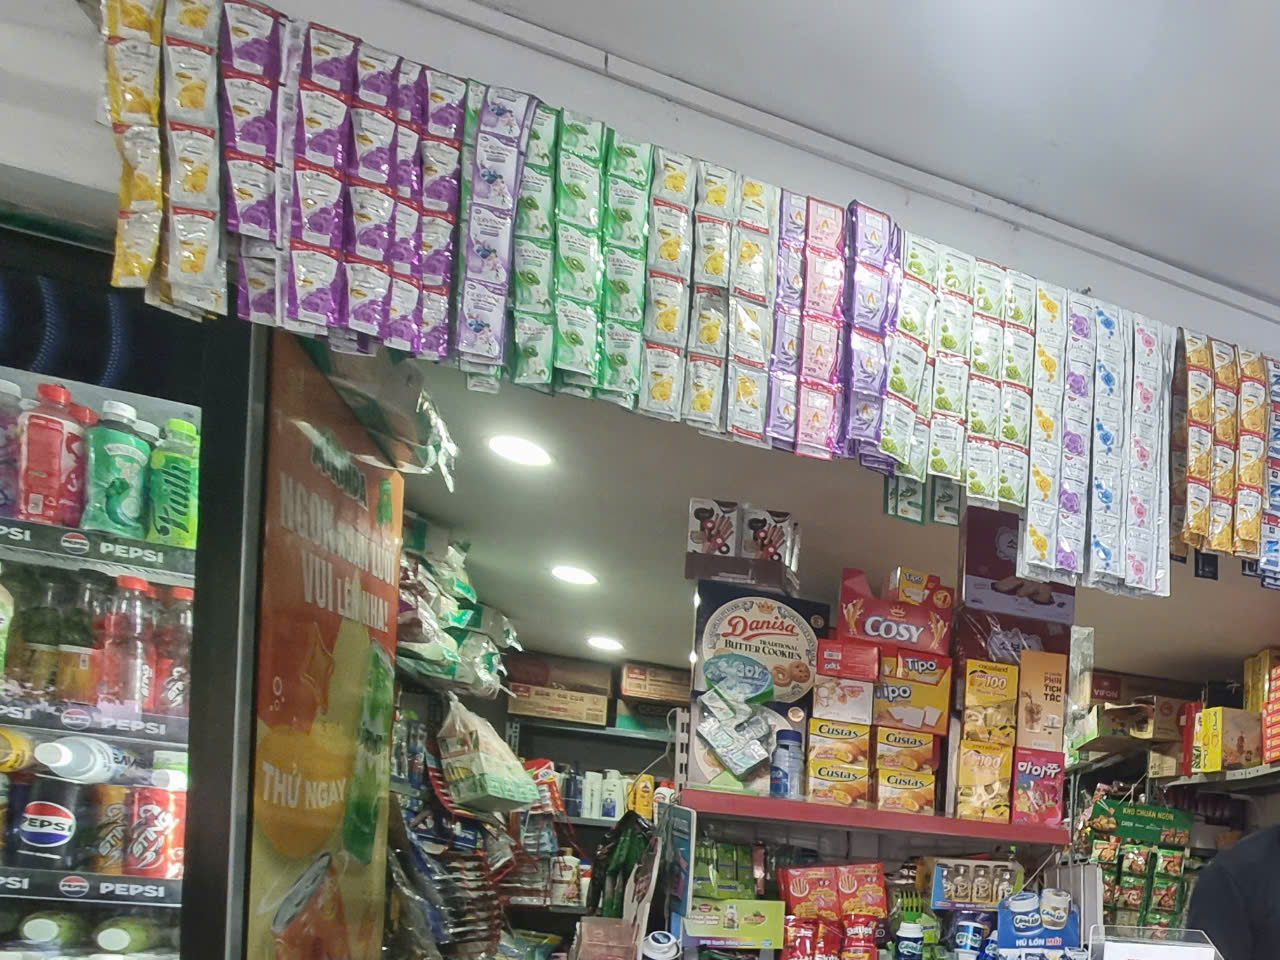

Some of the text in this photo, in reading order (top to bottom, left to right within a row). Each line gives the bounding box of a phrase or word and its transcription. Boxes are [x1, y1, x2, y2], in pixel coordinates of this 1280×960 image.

[100, 542, 164, 564] PEPSI
[721, 615, 800, 640] Danisa
[865, 616, 925, 643] COSY
[724, 638, 803, 661] BUTTER COOKIES
[759, 638, 799, 652] TRADITIONAL
[905, 657, 938, 675] Tipo
[984, 676, 1008, 690] 100
[818, 723, 859, 738] Custas
[886, 732, 925, 746] Custas
[818, 766, 859, 781] Custas
[887, 774, 926, 788] Custas
[305, 777, 347, 809] NGAY
[100, 882, 166, 898] PEPSI
